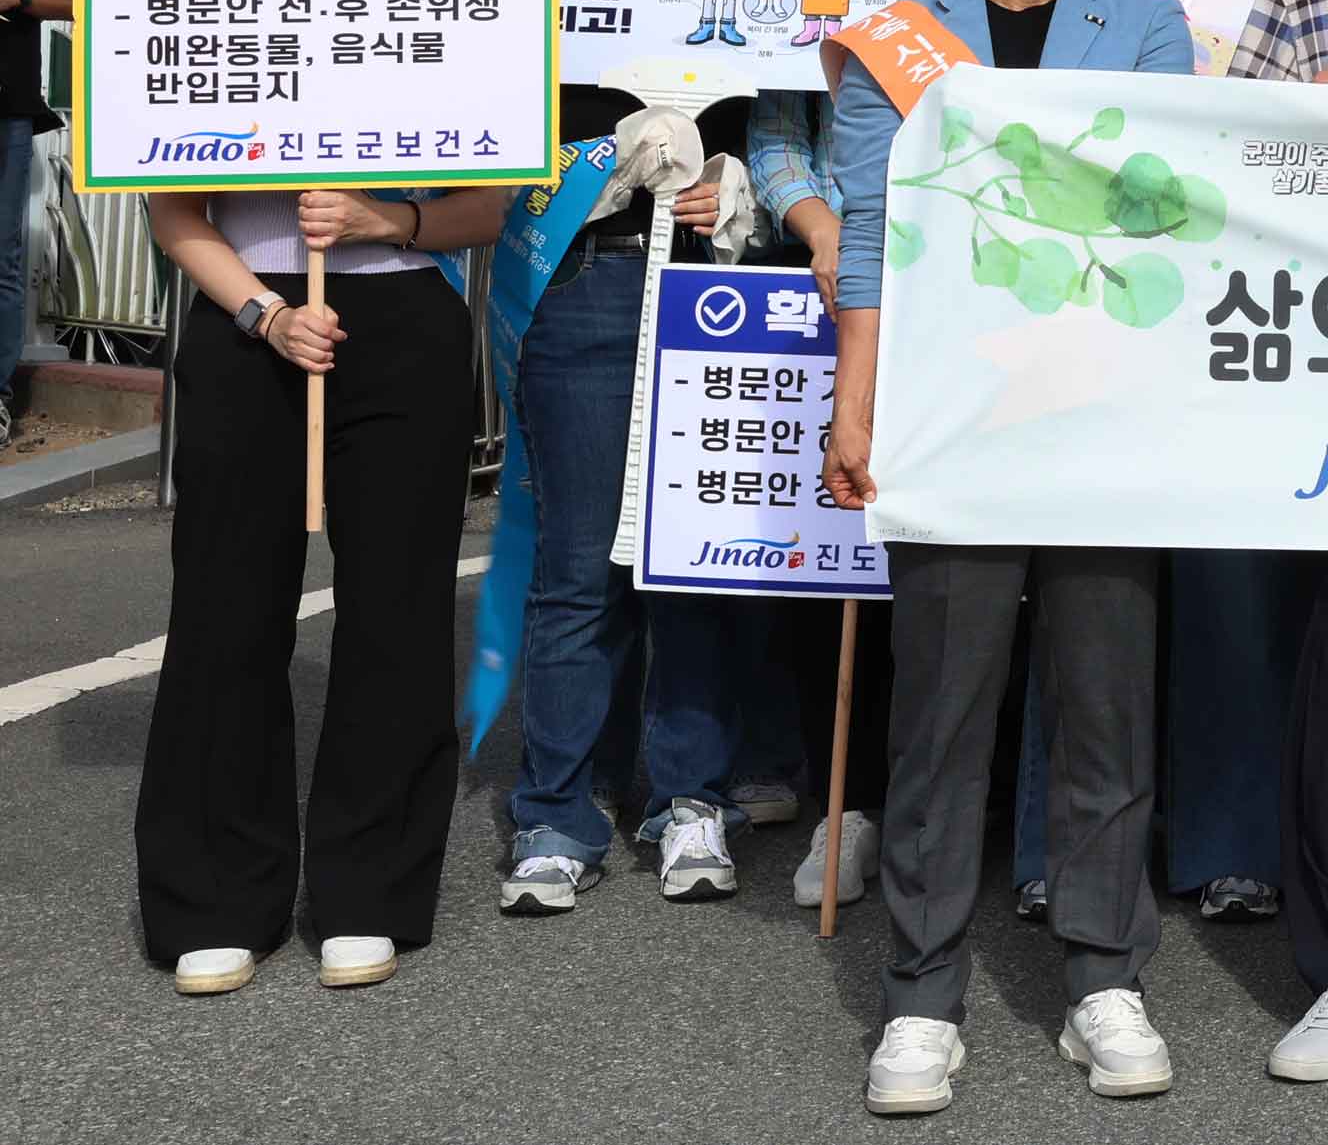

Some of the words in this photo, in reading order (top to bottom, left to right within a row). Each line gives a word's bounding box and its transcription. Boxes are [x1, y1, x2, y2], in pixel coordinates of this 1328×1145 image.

[147, 34, 313, 67] 애완동물,
[331, 31, 444, 64] 음식물
[146, 71, 300, 105] 반입금지
[138, 136, 245, 166] Jindo
[1242, 141, 1306, 166] 군민이
[703, 365, 809, 403] 병문안
[700, 417, 805, 456] 병문안
[697, 470, 802, 507] 병문안
[690, 541, 785, 569] Jindo
[816, 543, 877, 572] 진도
